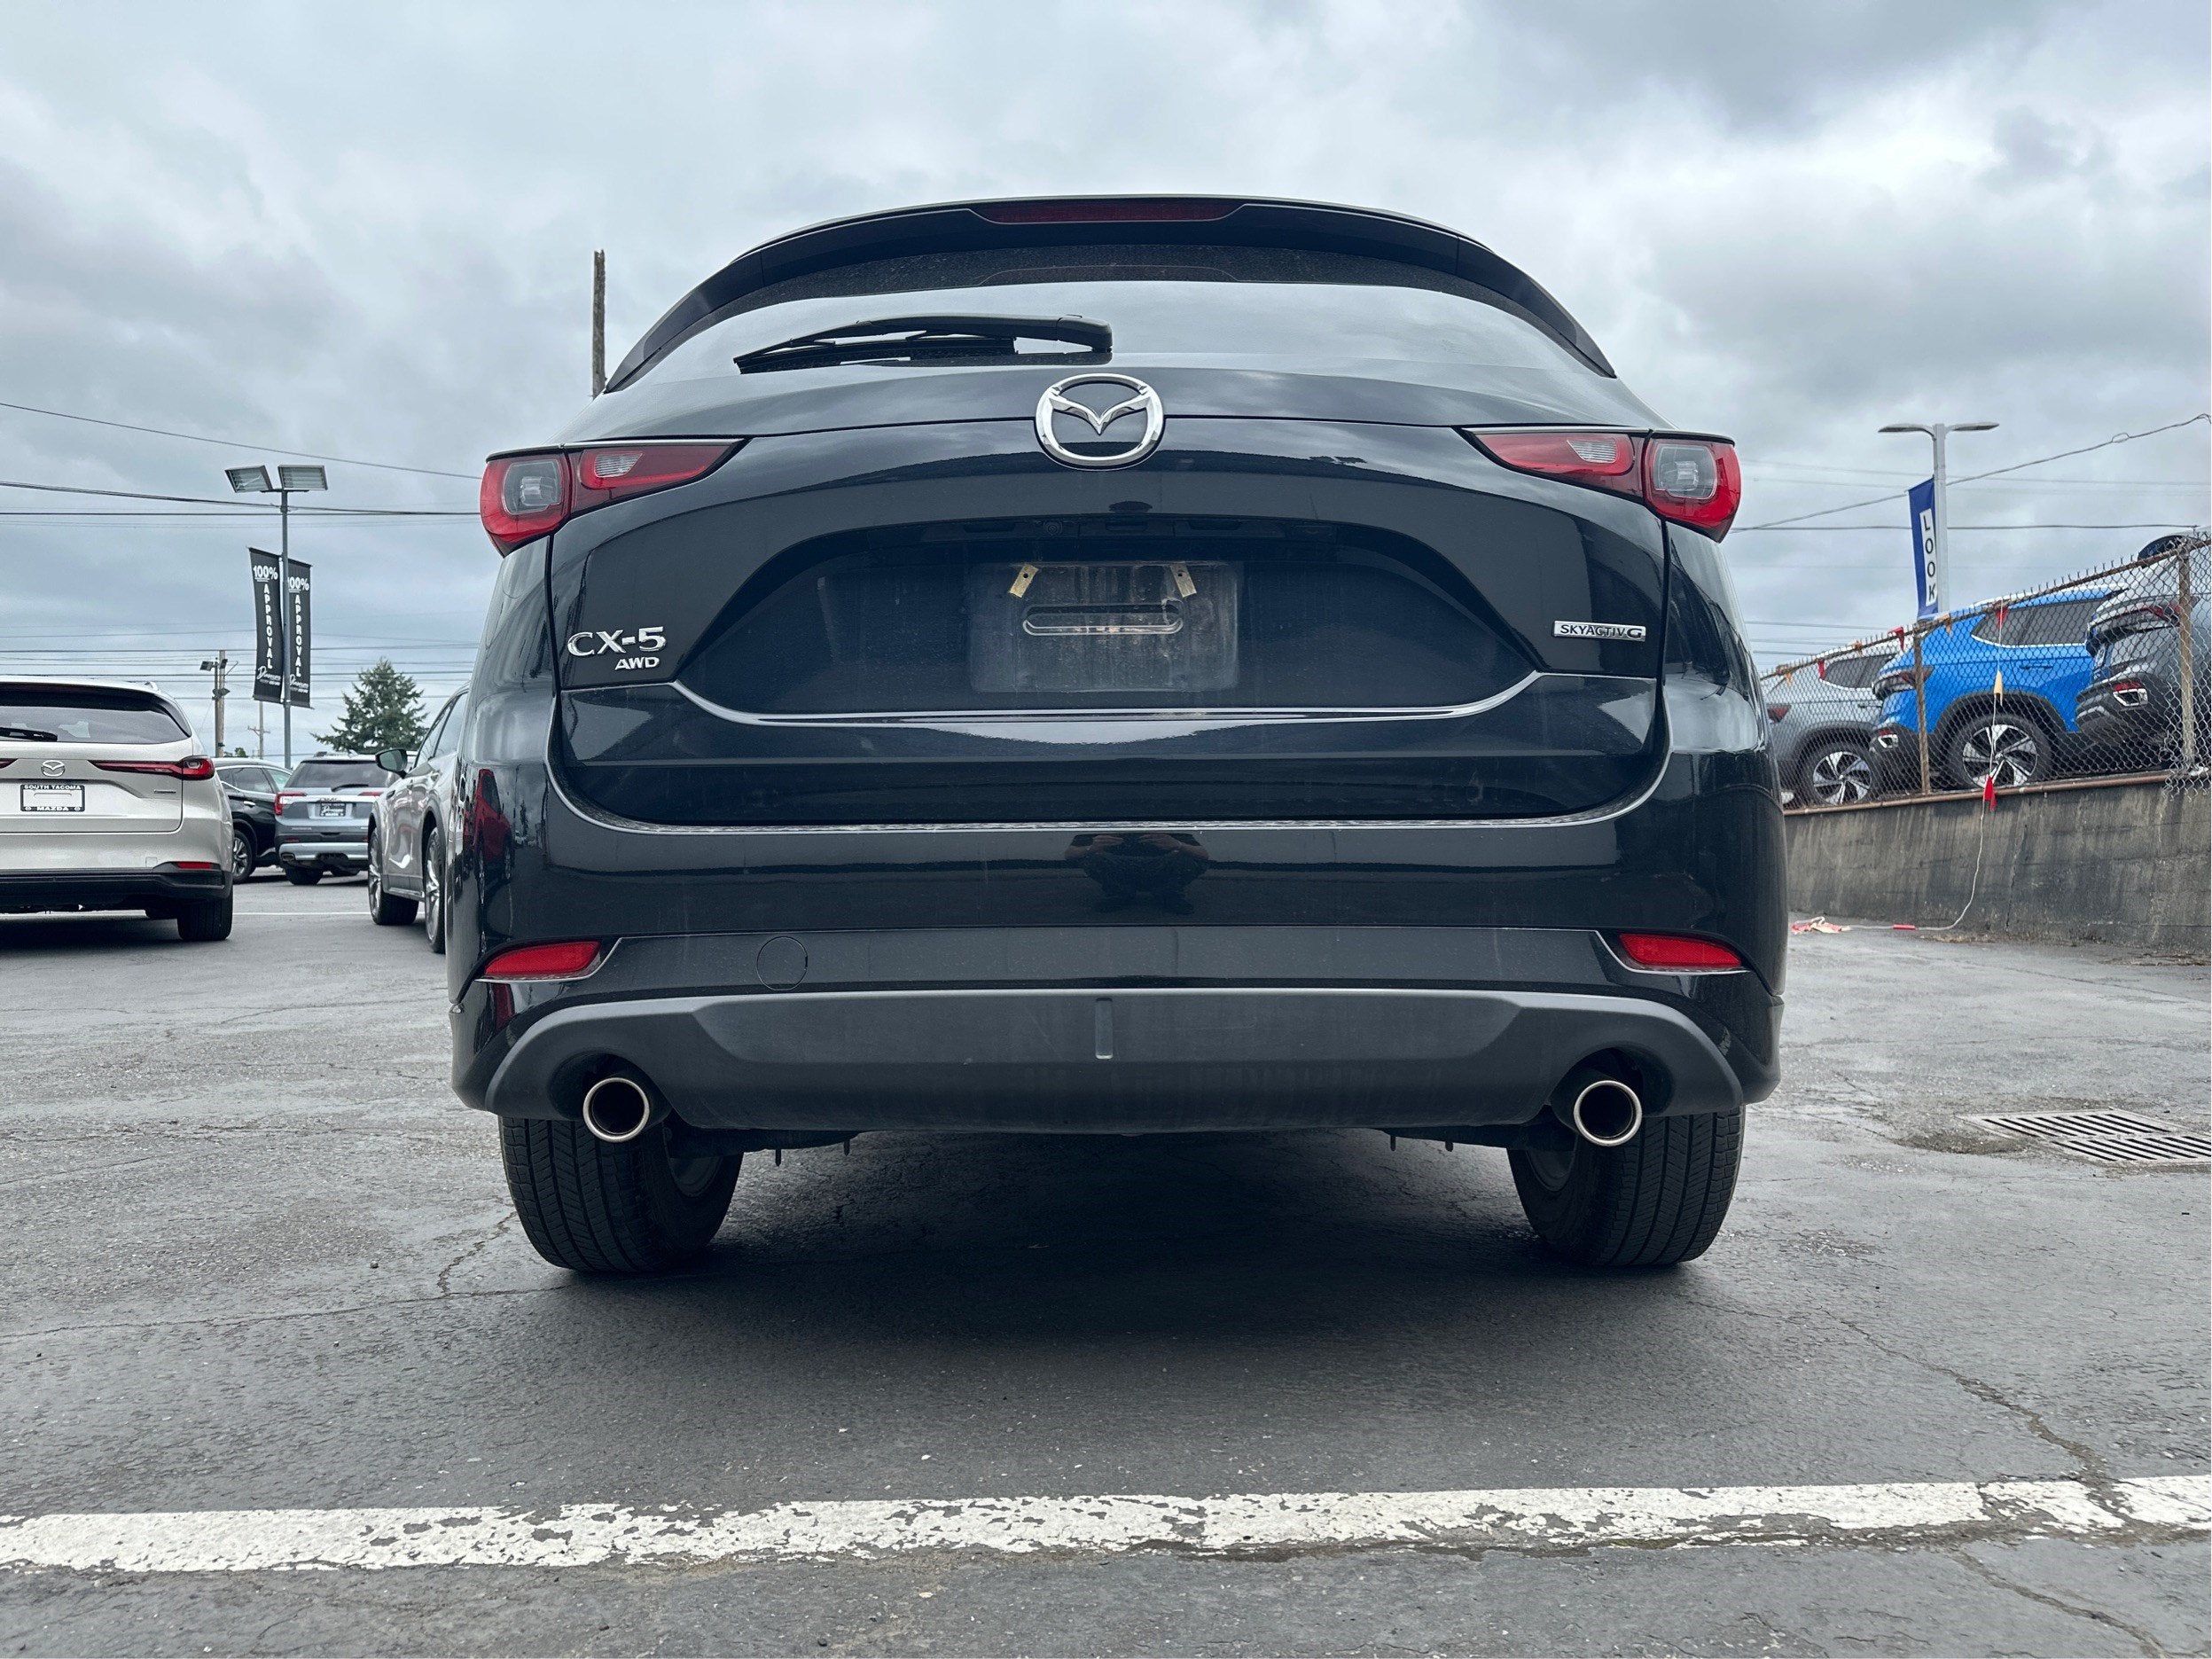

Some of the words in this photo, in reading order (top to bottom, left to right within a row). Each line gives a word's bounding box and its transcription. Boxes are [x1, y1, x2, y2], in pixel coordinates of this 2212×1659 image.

[253, 565, 278, 580] 100%
[1923, 514, 1936, 603] LOOK
[263, 583, 272, 669] APPROVAL
[567, 626, 666, 656] CX-5
[614, 656, 660, 670] AWD
